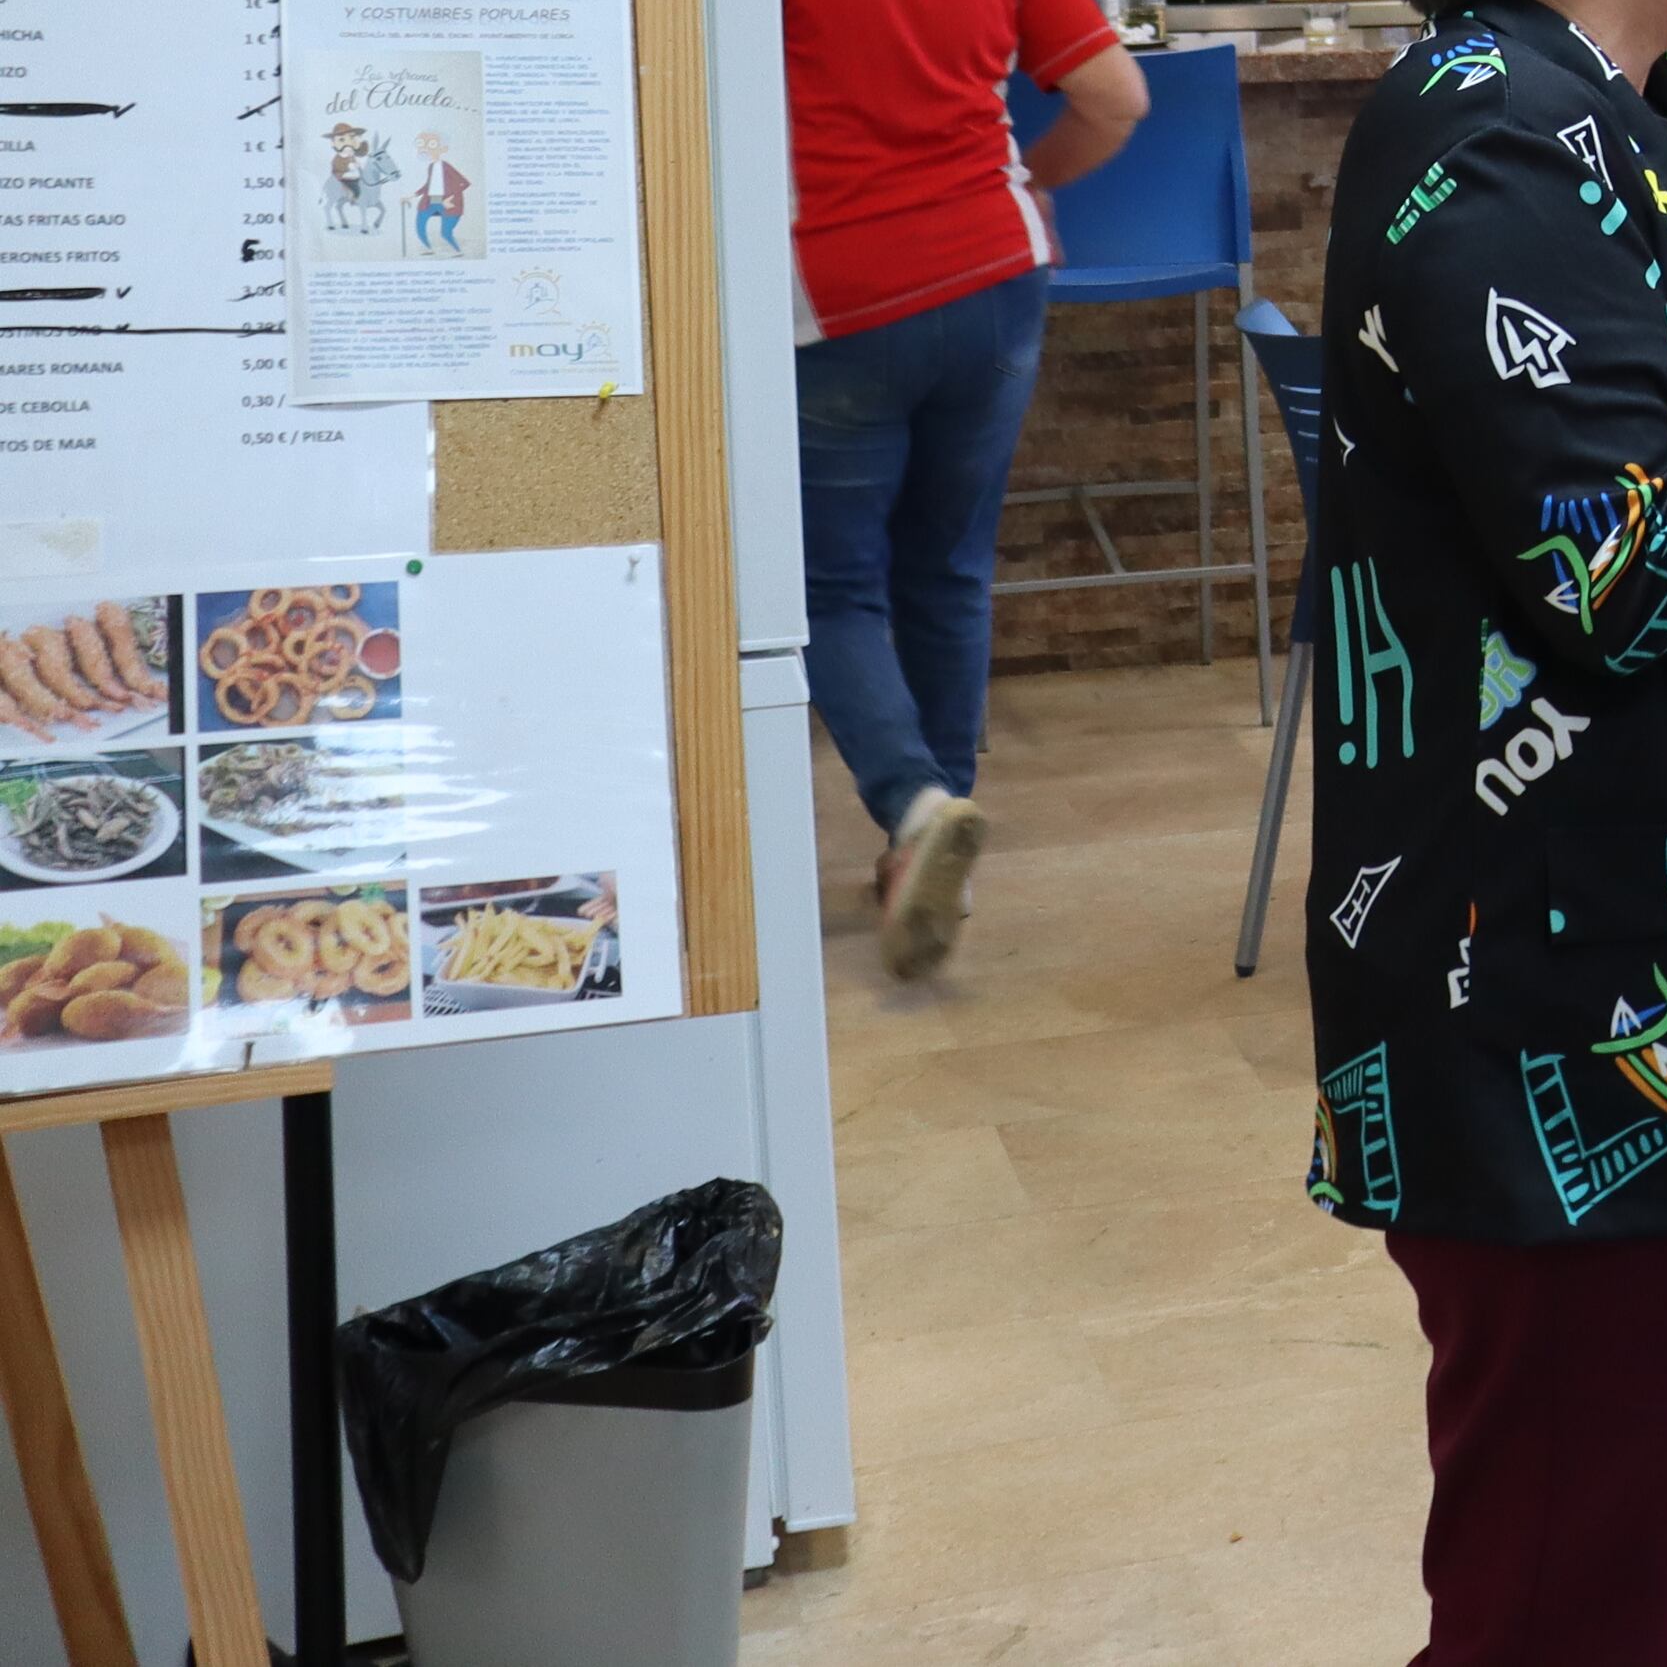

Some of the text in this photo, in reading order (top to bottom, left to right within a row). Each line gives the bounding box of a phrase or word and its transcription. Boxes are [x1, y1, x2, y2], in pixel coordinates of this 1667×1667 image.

[344, 7, 571, 22] Y COSTUMBRES POPULARES
[257, 34, 267, 45] €
[256, 70, 267, 81] €
[325, 89, 359, 115] del
[256, 142, 266, 153] €
[28, 177, 95, 190] PICANTE
[243, 177, 275, 191] 1,50
[28, 214, 81, 226] FRITAS
[85, 214, 127, 226] GAJO
[243, 213, 275, 226] 2,00
[0, 252, 62, 264] ERONES
[66, 250, 121, 263] FRITOS
[51, 362, 124, 375] ROMANA
[242, 358, 275, 372] 5,00
[21, 400, 91, 414] CEBOLLA
[241, 395, 275, 408] 0,30
[33, 438, 54, 452] DE
[58, 437, 97, 451] MAR
[241, 432, 275, 446] 0,50
[278, 432, 287, 445] €
[302, 430, 345, 443] PIEZA
[1475, 697, 1592, 817] YOU
